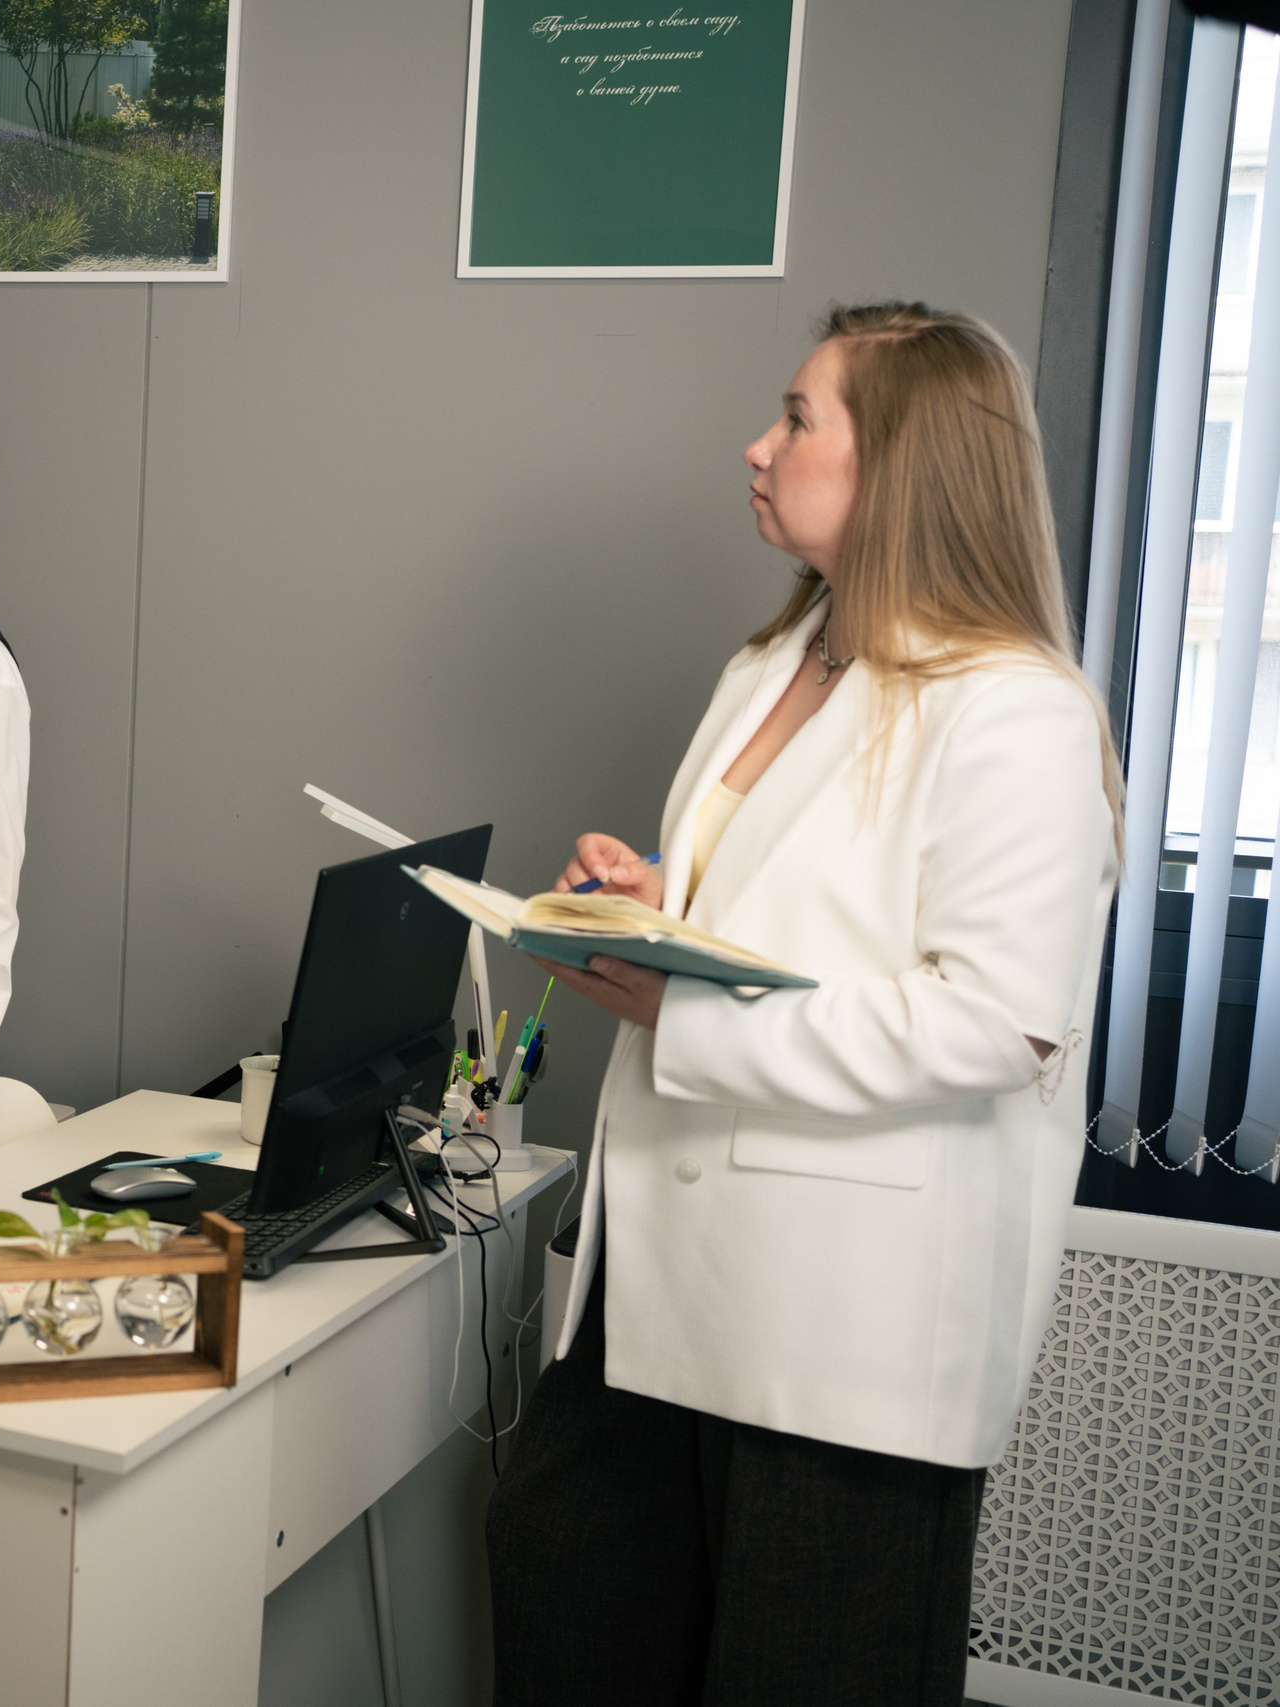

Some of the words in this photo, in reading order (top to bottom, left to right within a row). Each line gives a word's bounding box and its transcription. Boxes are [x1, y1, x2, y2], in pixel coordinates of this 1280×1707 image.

[646, 19, 654, 28] о
[659, 7, 700, 28] своем
[704, 15, 741, 36] саду,
[560, 55, 570, 64] а
[574, 54, 599, 75] сад
[603, 45, 704, 74] позаботится
[576, 88, 585, 96] о
[589, 77, 635, 96] вашей
[629, 84, 682, 106] душе.
